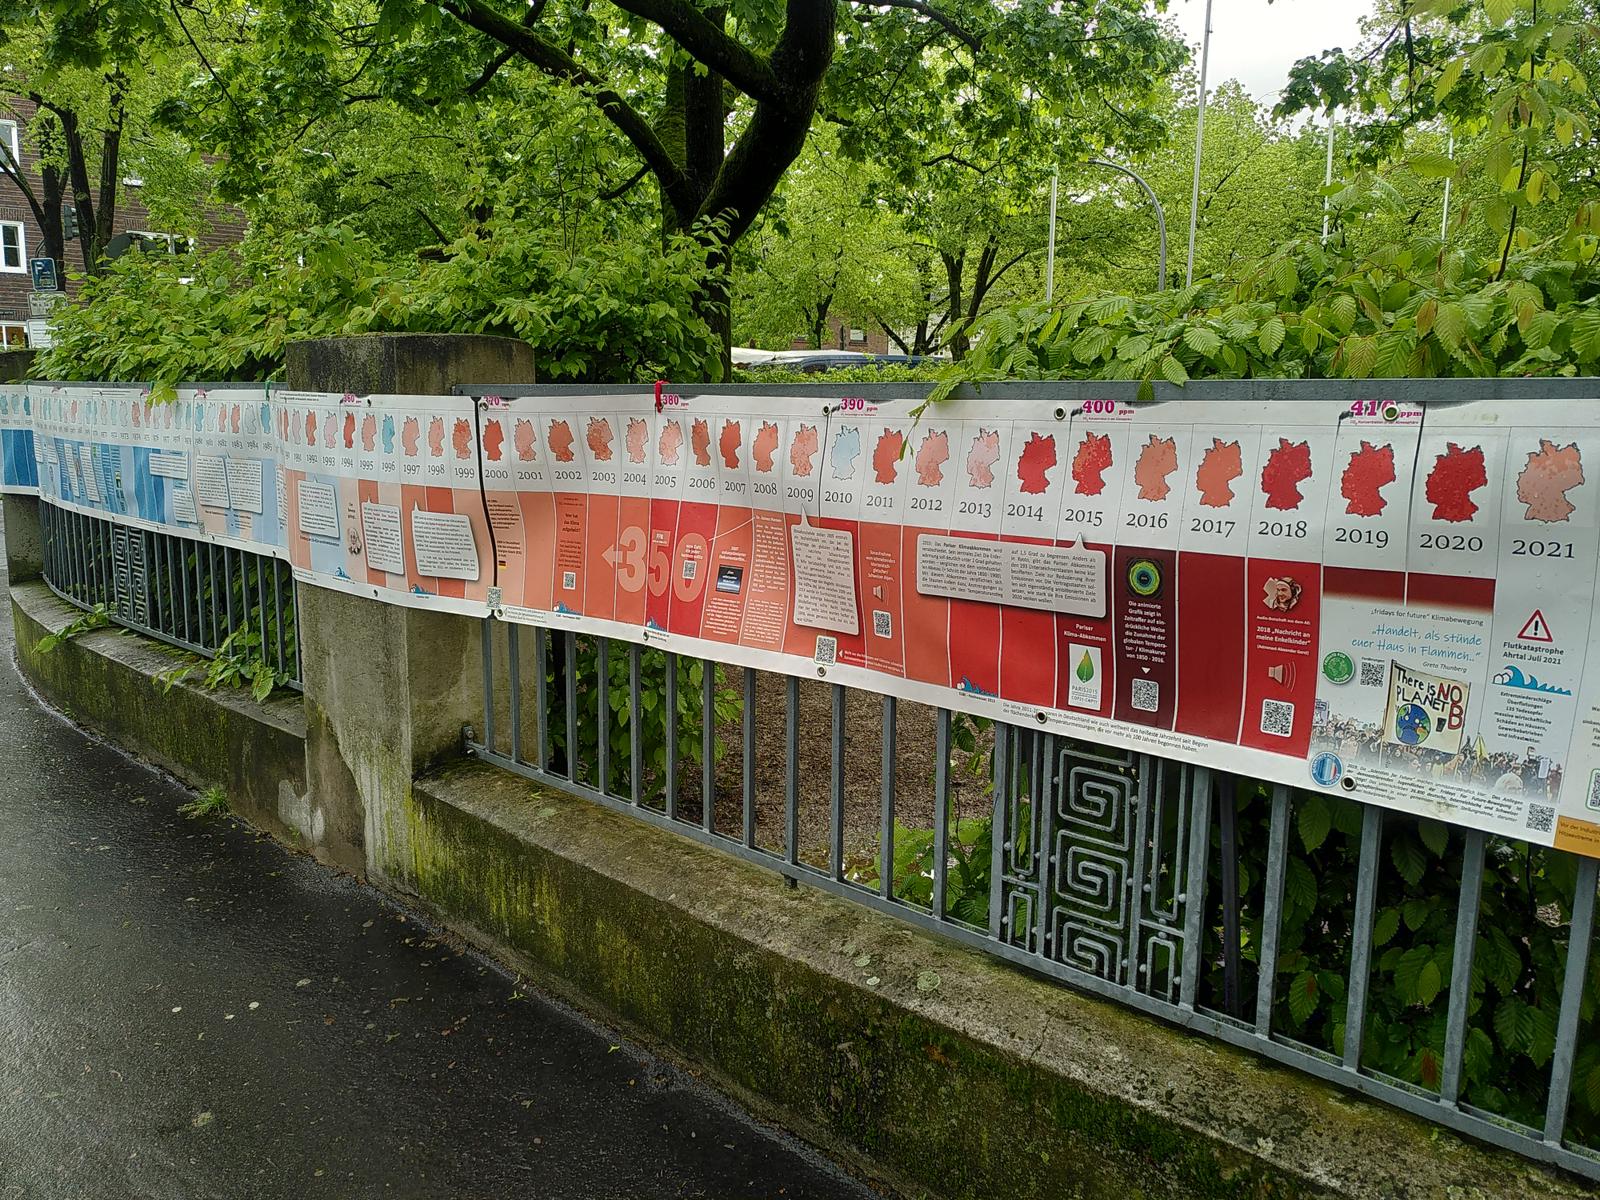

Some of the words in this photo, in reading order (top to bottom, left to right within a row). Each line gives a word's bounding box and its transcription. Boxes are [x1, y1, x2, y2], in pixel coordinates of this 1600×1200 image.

[662, 395, 679, 405] 380
[840, 398, 864, 411] 390
[1082, 400, 1115, 414] 400
[231, 440, 243, 450] 1983
[262, 441, 273, 451] 1985
[306, 454, 318, 464] 1992
[322, 456, 336, 467] 1993
[341, 457, 354, 468] 1994
[360, 460, 374, 471] 1995
[381, 461, 396, 473] 1996
[403, 464, 421, 475] 1997
[427, 464, 445, 476] 1998
[454, 467, 475, 479] 1999
[485, 469, 509, 479] 2000
[517, 471, 543, 480] 2001
[554, 470, 583, 480] 2002
[592, 471, 616, 484] 2003
[623, 472, 647, 485] 2004
[655, 475, 676, 488] 2005
[689, 477, 716, 489] 2006
[725, 481, 746, 495] 2007
[753, 482, 778, 495] 2008
[787, 487, 814, 502] 2009
[824, 490, 853, 504] 2010
[866, 495, 894, 508] 2011
[910, 497, 943, 511] 2012
[959, 501, 992, 519] 2013
[1007, 503, 1044, 522] 2014
[1065, 508, 1104, 527] 2015
[1126, 512, 1169, 529] 2016
[1190, 518, 1236, 538] 2017
[1258, 520, 1308, 538] 2018
[1335, 527, 1389, 549] 2019
[1419, 533, 1484, 552] 2020
[1511, 539, 1576, 559] 2021
[617, 526, 708, 602] 350
[1138, 602, 1161, 610] animierte
[1075, 623, 1094, 632] Pariser
[1125, 623, 1149, 631] drückliche
[1431, 615, 1484, 627] Klimabewegung
[1063, 630, 1107, 642] Klima-Abkommen
[1133, 631, 1156, 639] Zunahme
[1424, 630, 1440, 641] als
[1444, 633, 1482, 646] stünde
[1138, 647, 1166, 656] Klimakurve
[1145, 641, 1168, 649] Tempera-
[1351, 638, 1375, 649] euer
[1377, 640, 1405, 653] Haus
[1408, 643, 1417, 653] in
[1503, 641, 1565, 656] Flutkatastrophe
[1502, 651, 1527, 661] Ahrtal
[1528, 653, 1542, 663] Juli
[1543, 656, 1562, 665] 2021
[1422, 661, 1439, 669] Greta
[1440, 663, 1468, 674] Thunberg
[1071, 685, 1098, 694] PARIS2015
[1394, 664, 1425, 691] There
[1427, 682, 1436, 697] is
[1436, 682, 1463, 703] NO
[1500, 691, 1552, 704] Extremniederschläge
[1507, 698, 1543, 709] Überflutungen
[1395, 685, 1450, 713] PLANET
[1447, 703, 1464, 730] B
[1516, 707, 1544, 717] Todesopfer
[1494, 711, 1514, 719] massive
[1514, 714, 1552, 725] wirtschaftliche
[1496, 717, 1518, 726] Schäden
[1525, 722, 1548, 732] Häusern,
[1063, 713, 1090, 724] Deutschland
[1099, 720, 1110, 728] auch
[1110, 723, 1130, 732] weltweit
[1139, 728, 1159, 738] heißeste
[1159, 733, 1182, 743] Jahrzehnt
[1192, 739, 1209, 748] Beginn
[1498, 725, 1544, 737] Gewerbebetrieben
[1142, 736, 1157, 745] Jahren
[1157, 739, 1181, 749] begonnen
[1182, 744, 1198, 752] haben.
